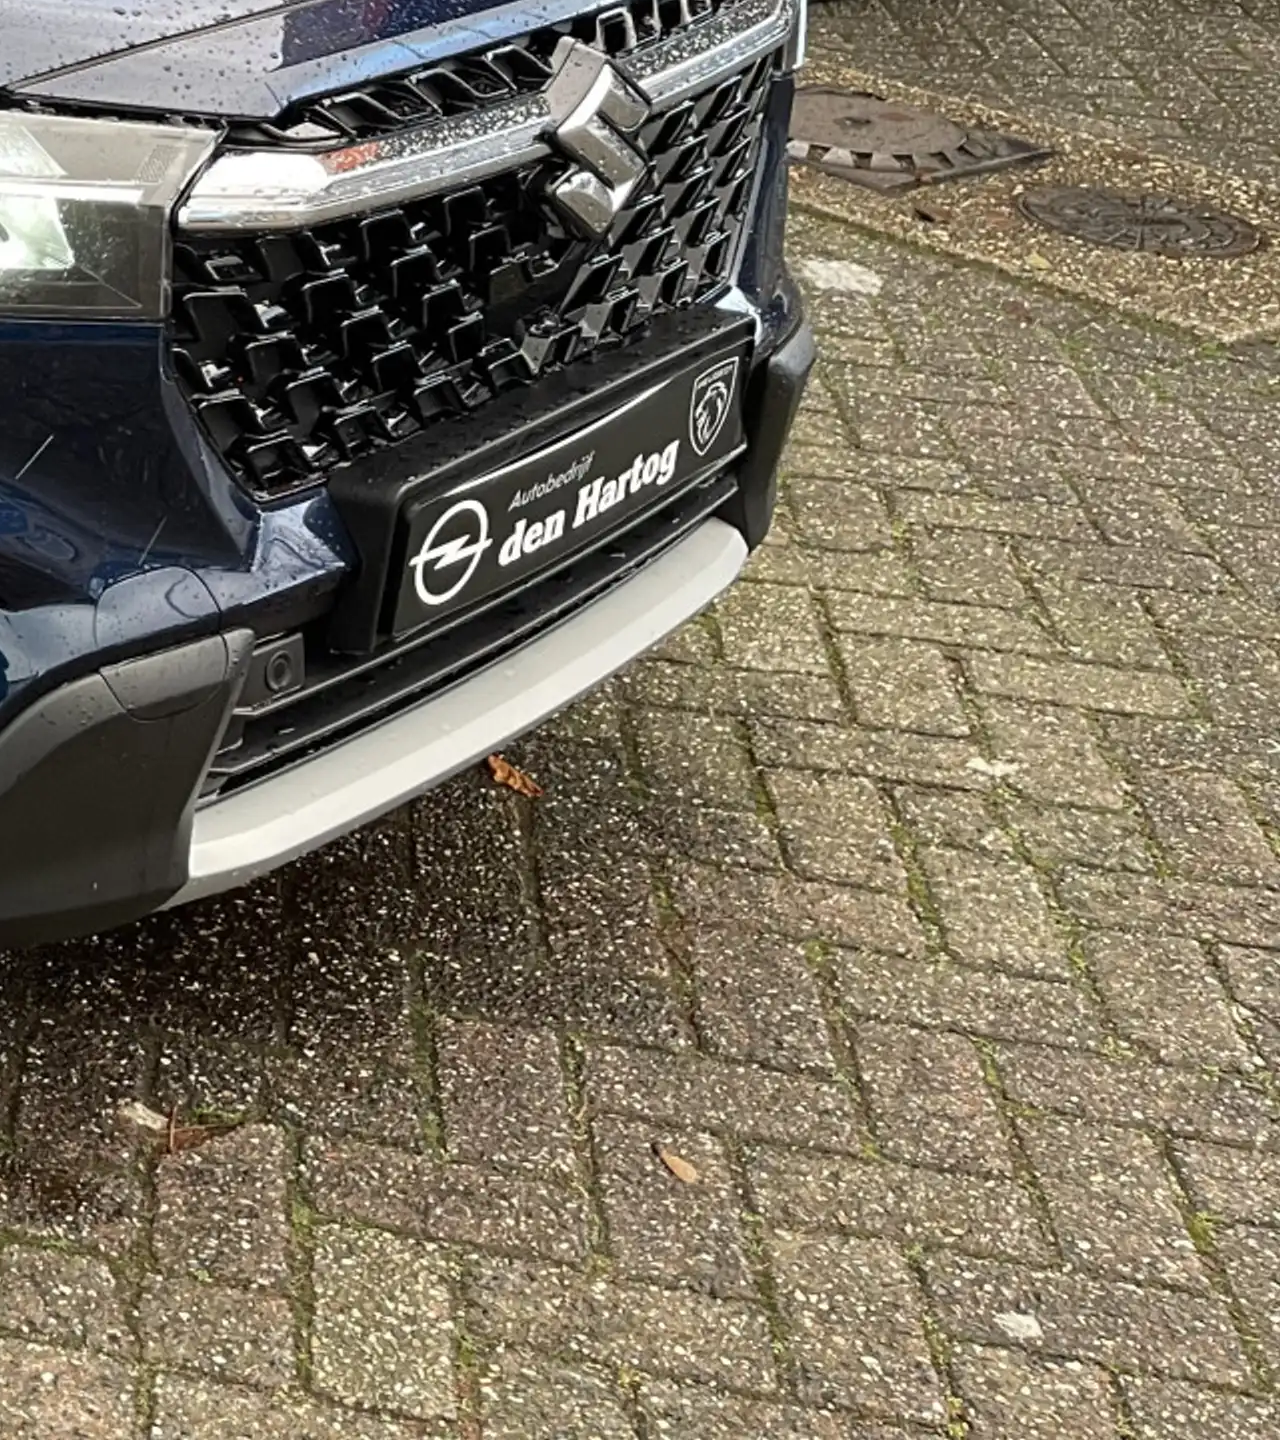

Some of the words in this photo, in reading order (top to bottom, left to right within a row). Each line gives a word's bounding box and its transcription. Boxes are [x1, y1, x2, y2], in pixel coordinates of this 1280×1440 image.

[498, 509, 564, 567] den
[572, 439, 680, 530] Hartog
[508, 450, 596, 512] Autobedrijf
